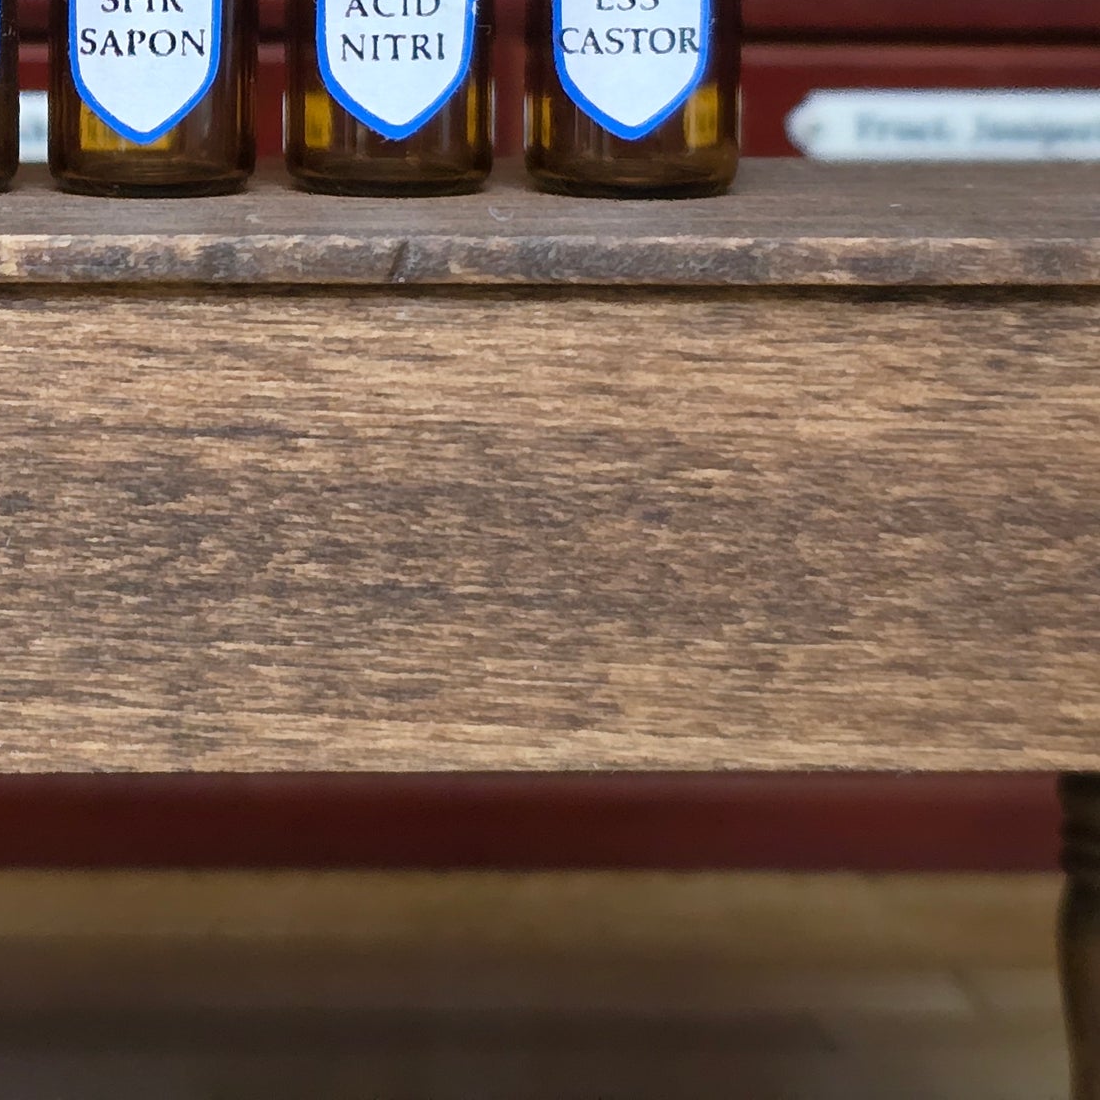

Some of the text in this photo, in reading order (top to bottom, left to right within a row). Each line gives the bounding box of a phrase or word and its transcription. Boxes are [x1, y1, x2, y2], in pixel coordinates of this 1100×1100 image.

[80, 27, 205, 57] SAPON
[341, 32, 445, 62] NITRI
[558, 27, 700, 55] CASTOR
